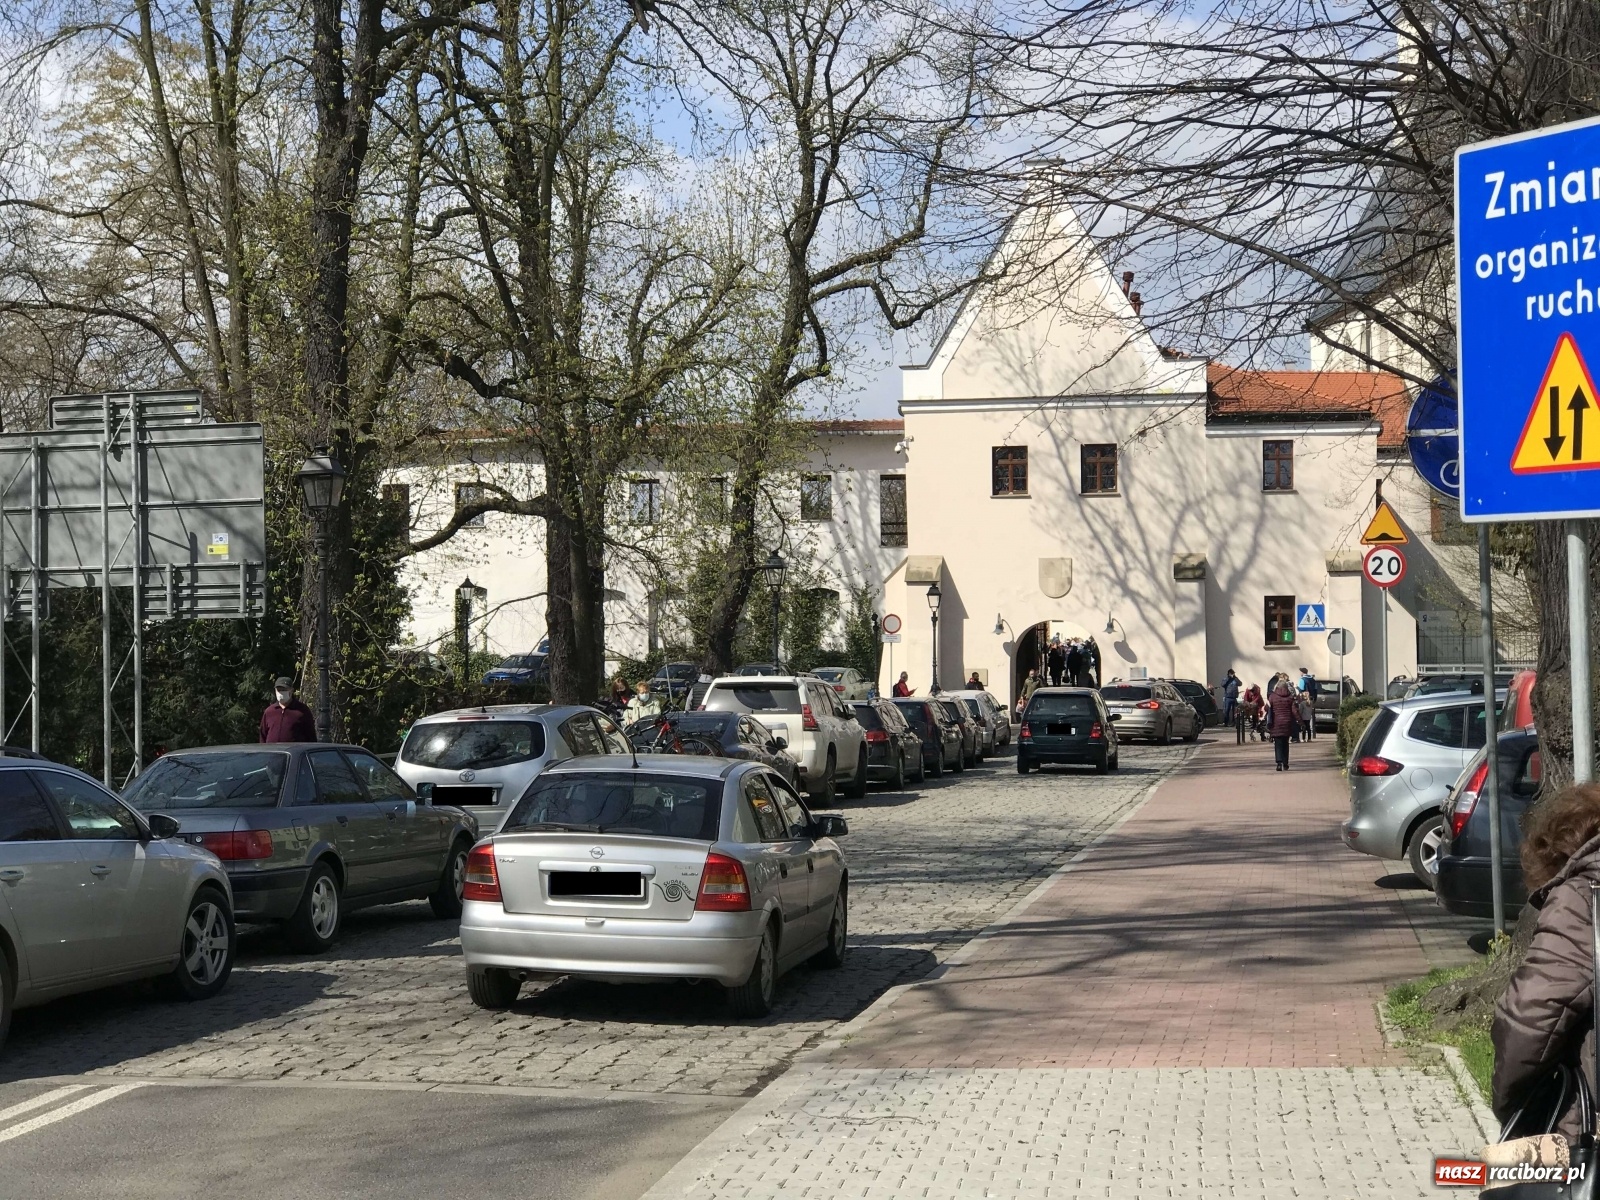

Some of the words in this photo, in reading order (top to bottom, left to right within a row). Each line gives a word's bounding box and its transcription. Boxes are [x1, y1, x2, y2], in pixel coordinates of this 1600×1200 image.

[1475, 226, 1600, 283] organiz
[1526, 278, 1600, 321] ruch
[1371, 556, 1401, 576] 20
